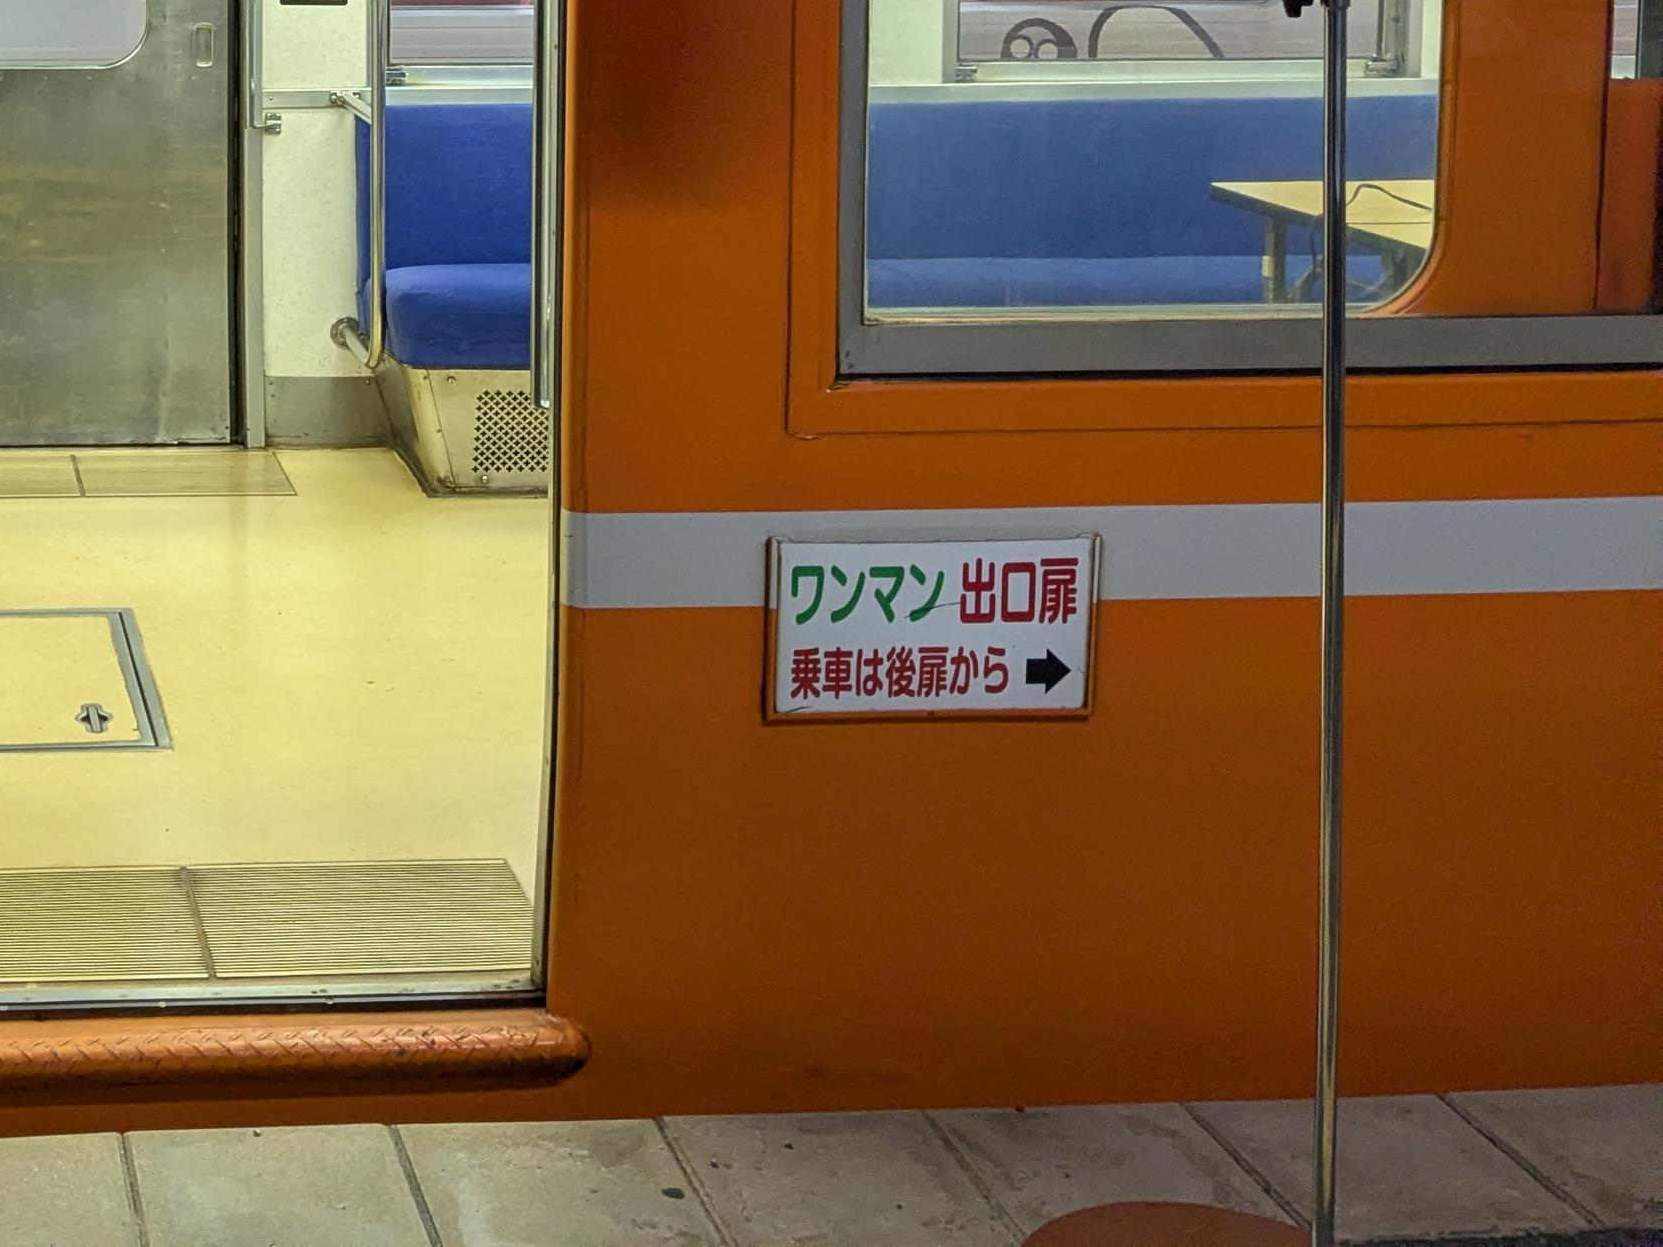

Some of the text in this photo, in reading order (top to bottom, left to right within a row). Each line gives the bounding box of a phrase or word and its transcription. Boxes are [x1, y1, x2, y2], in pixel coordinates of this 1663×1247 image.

[791, 557, 1079, 625] ワンマン 出口扉
[791, 646, 1010, 700] 乗車は後扉から
